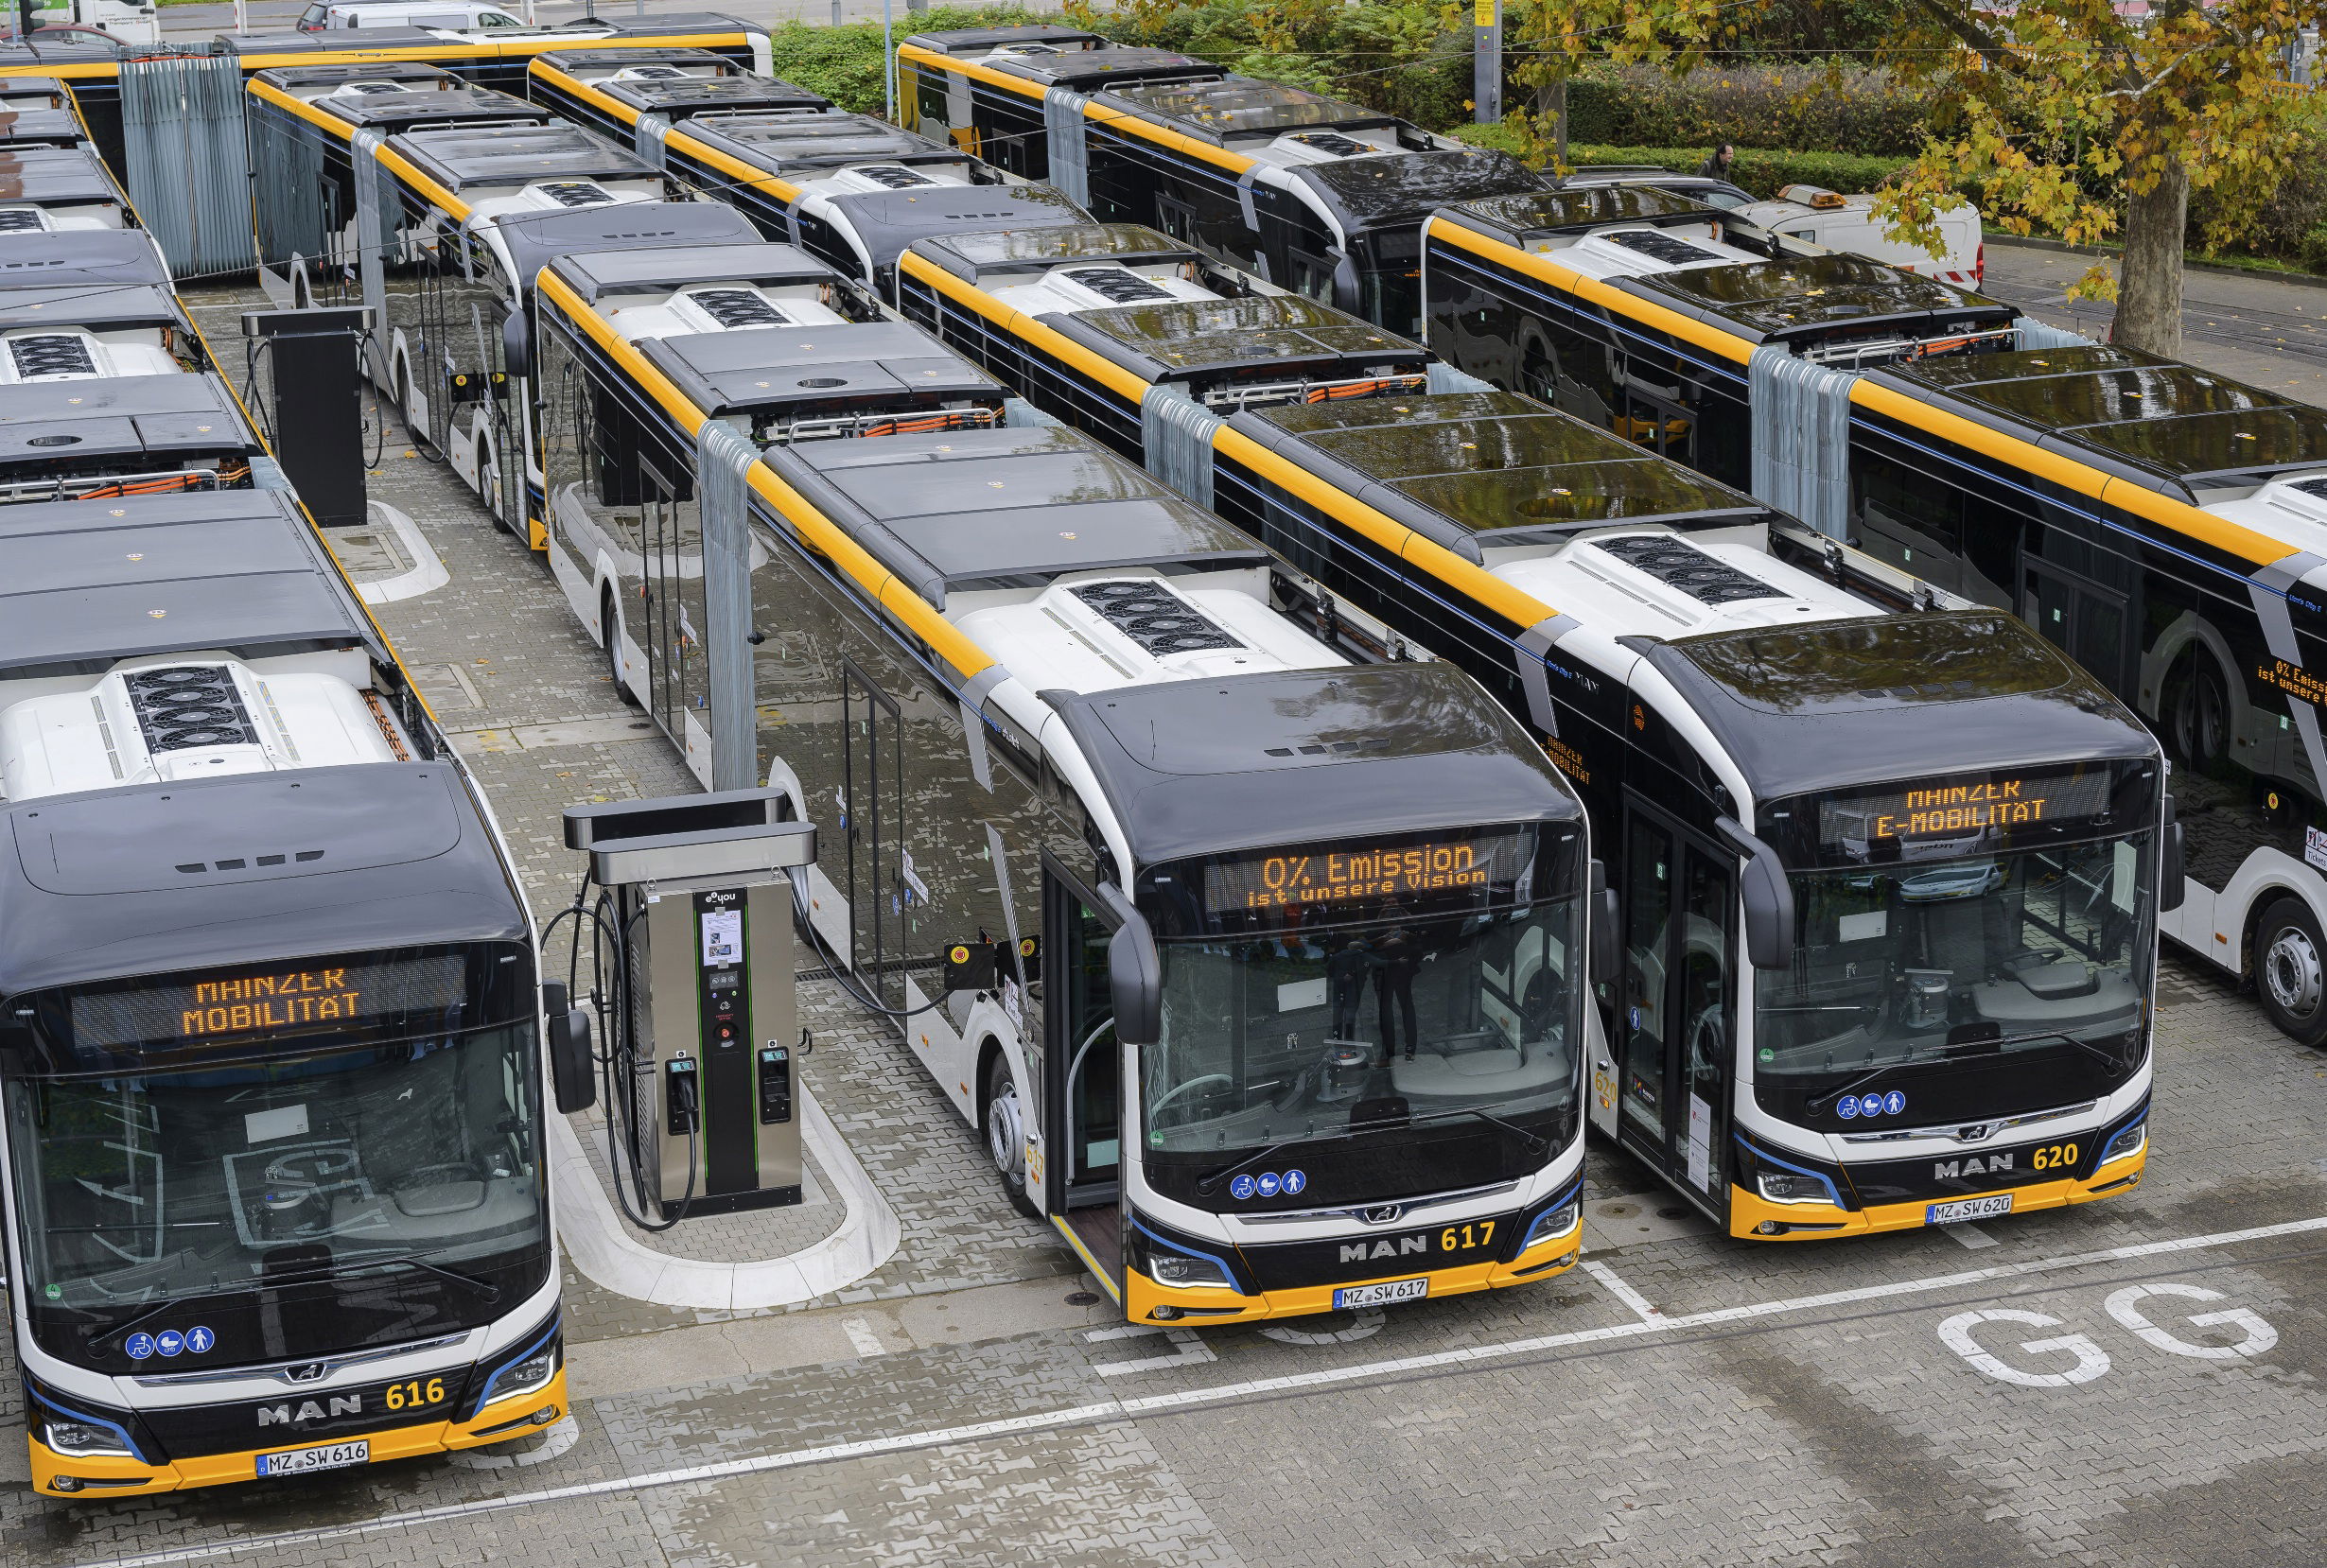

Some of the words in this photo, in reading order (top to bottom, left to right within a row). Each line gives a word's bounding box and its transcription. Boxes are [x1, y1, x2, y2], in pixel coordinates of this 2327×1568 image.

[2258, 666, 2275, 683] ist
[2279, 677, 2320, 703] unsere
[2276, 660, 2290, 678] 0%
[1907, 780, 2021, 809] MAINZER
[1877, 799, 2045, 837] E-MOBILITÄT
[1263, 855, 1310, 889] 0%
[1327, 845, 1473, 884] Emission
[2308, 851, 2327, 867] Tickets
[1249, 888, 1287, 907] ist
[1301, 880, 1394, 901] unsere
[197, 968, 345, 1004] MAINZER
[183, 992, 360, 1035] MOBILITÄT
[1594, 1071, 1618, 1103] 620
[1025, 1144, 1044, 1176] 617
[1934, 1153, 2014, 1180] MAN
[2033, 1142, 2078, 1170] 620
[1934, 1204, 1954, 1220] MZ
[1962, 1201, 1982, 1216] SW
[1983, 1197, 2010, 1212] 620
[1339, 1235, 1426, 1263] MAN
[1441, 1221, 1496, 1251] 617
[1343, 1289, 1364, 1304] MZ
[1373, 1284, 1394, 1300] SW
[1396, 1281, 1426, 1298] 617
[257, 1394, 361, 1427] MAN
[386, 1377, 445, 1410] 616
[269, 1455, 293, 1472] MZ
[306, 1449, 328, 1467] SW
[332, 1444, 366, 1462] 616
